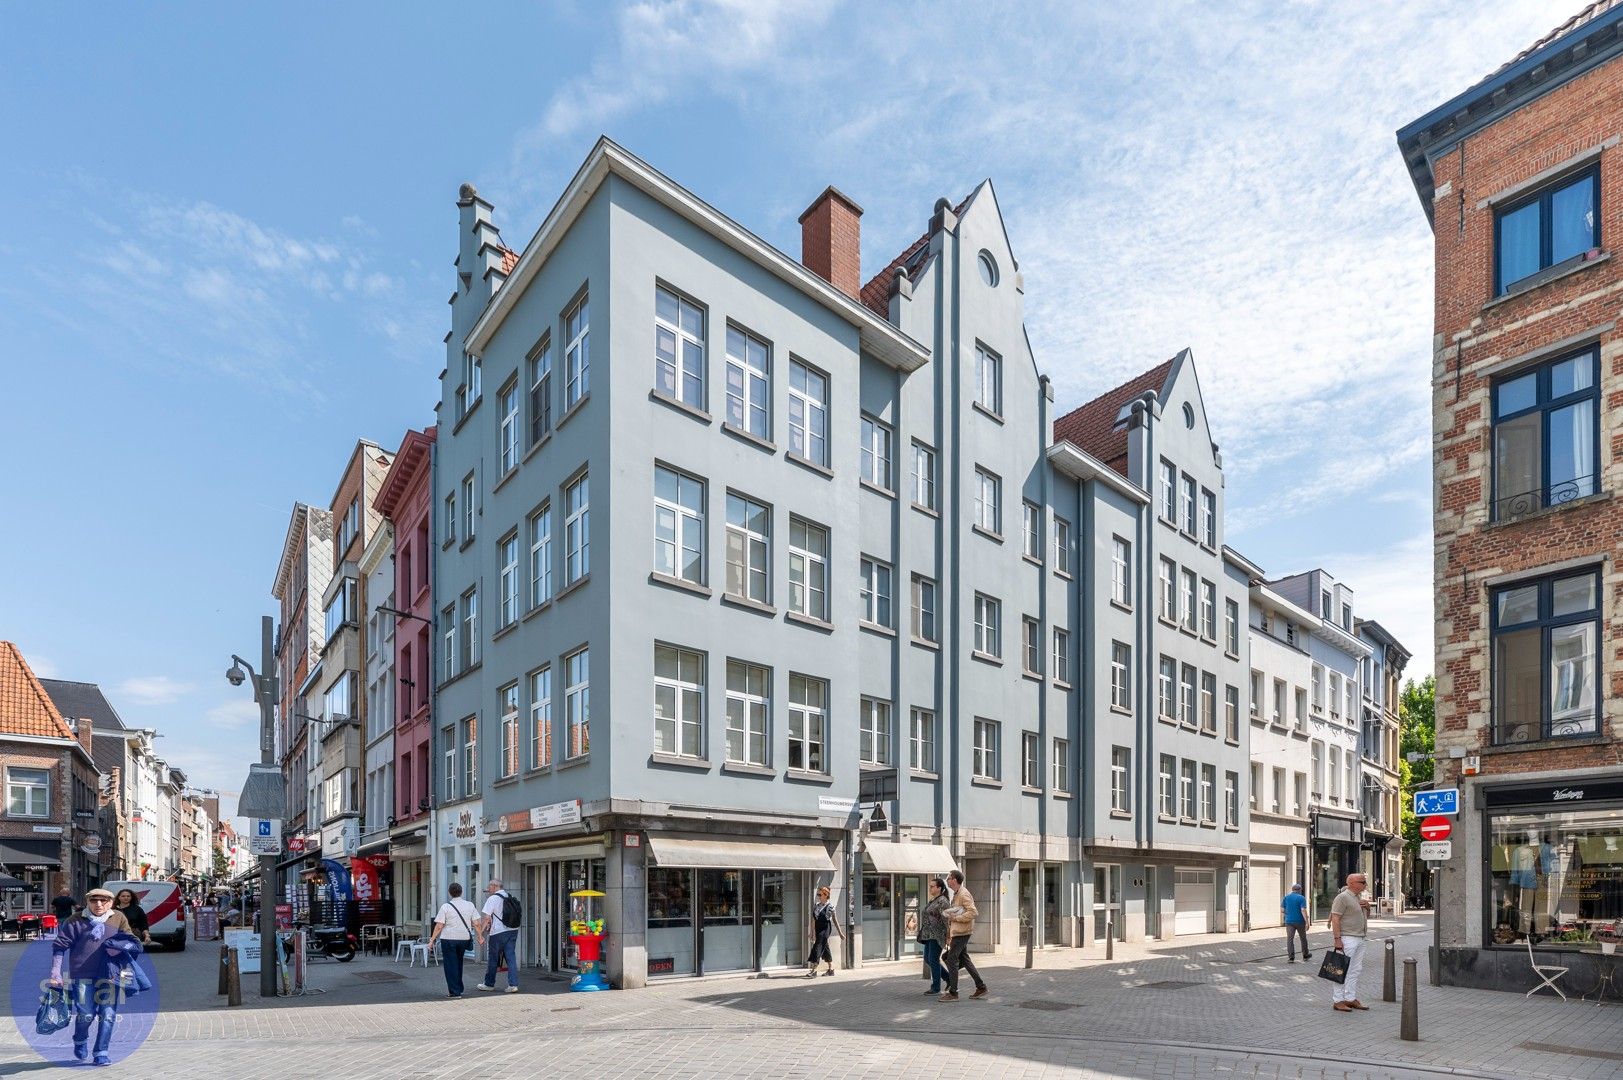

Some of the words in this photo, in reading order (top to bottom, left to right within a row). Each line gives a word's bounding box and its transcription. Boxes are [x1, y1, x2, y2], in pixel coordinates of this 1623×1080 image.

[456, 825, 476, 838] cookies
[290, 840, 303, 850] illy
[649, 962, 673, 972] OPEN
